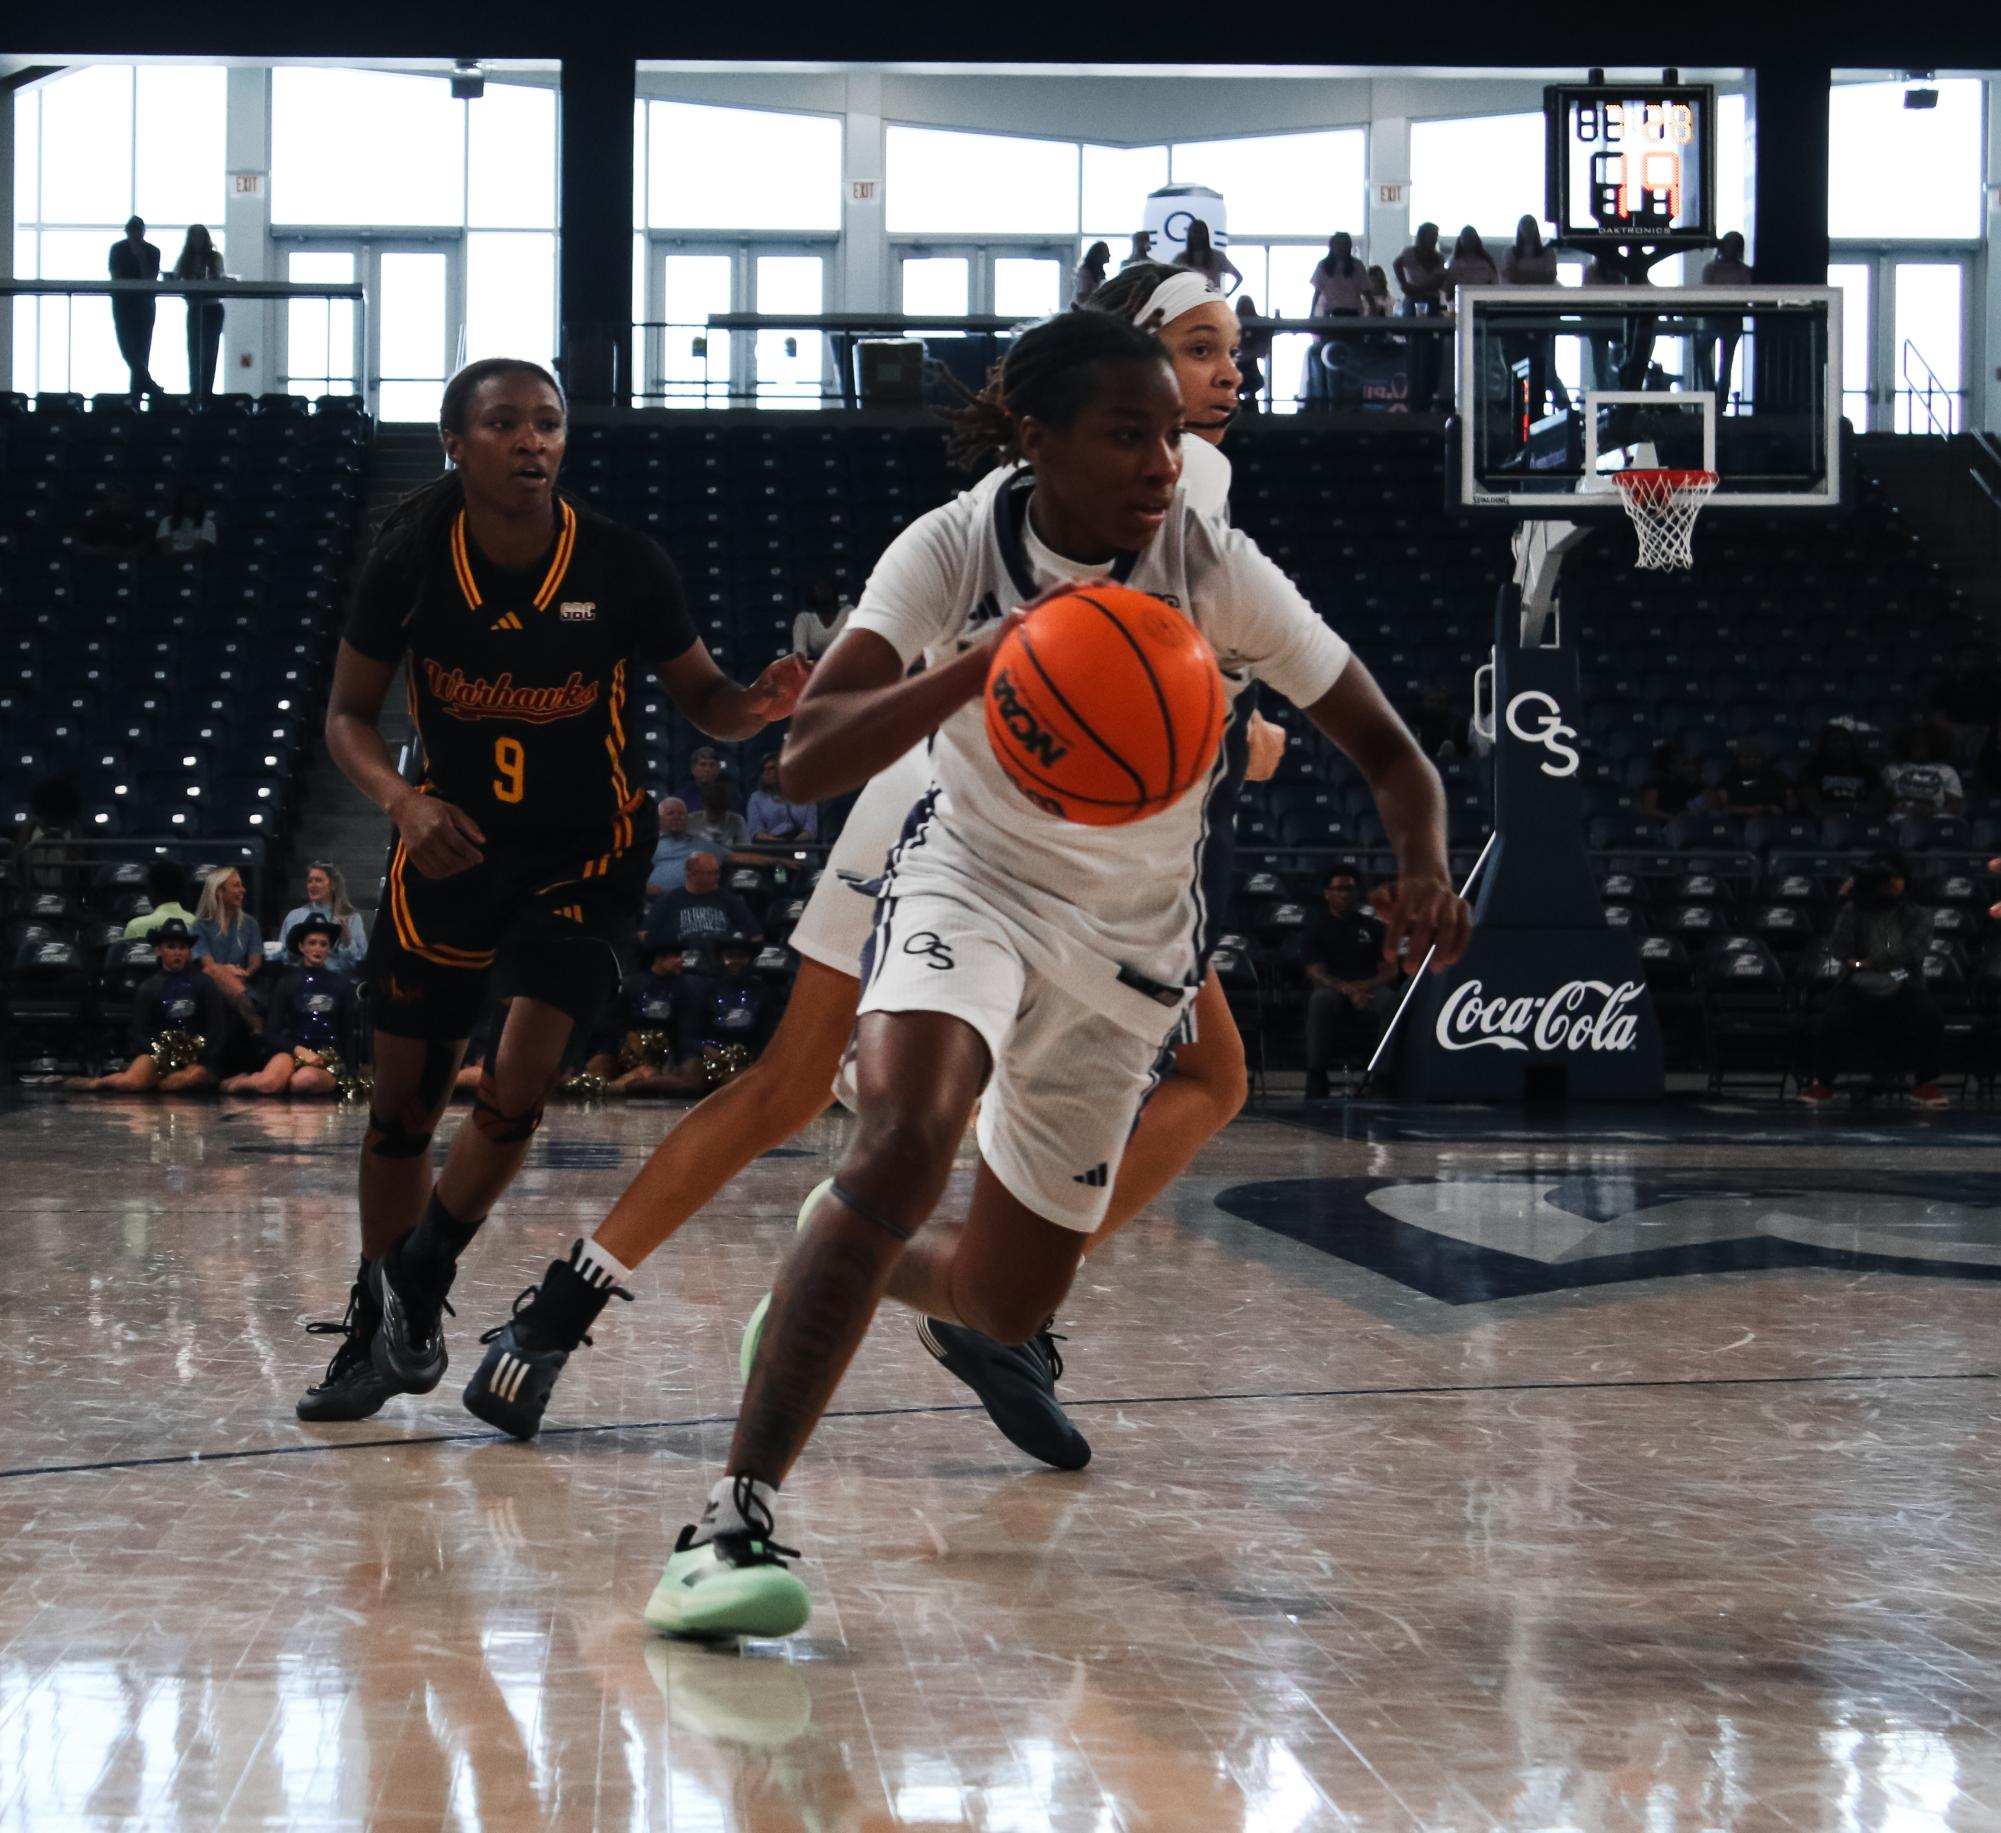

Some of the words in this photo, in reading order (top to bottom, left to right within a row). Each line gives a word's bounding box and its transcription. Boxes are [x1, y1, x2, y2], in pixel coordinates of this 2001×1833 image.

[236, 176, 257, 193] EXIT
[853, 182, 874, 199] EXIT
[1598, 226, 1671, 235] DAKTRONICS
[424, 658, 599, 712] Warhawks
[992, 667, 1068, 769] NCAA
[1505, 690, 1580, 777] GS
[493, 736, 525, 804] 9
[903, 931, 955, 971] GS
[1436, 979, 1646, 1051] Coca-Cola
